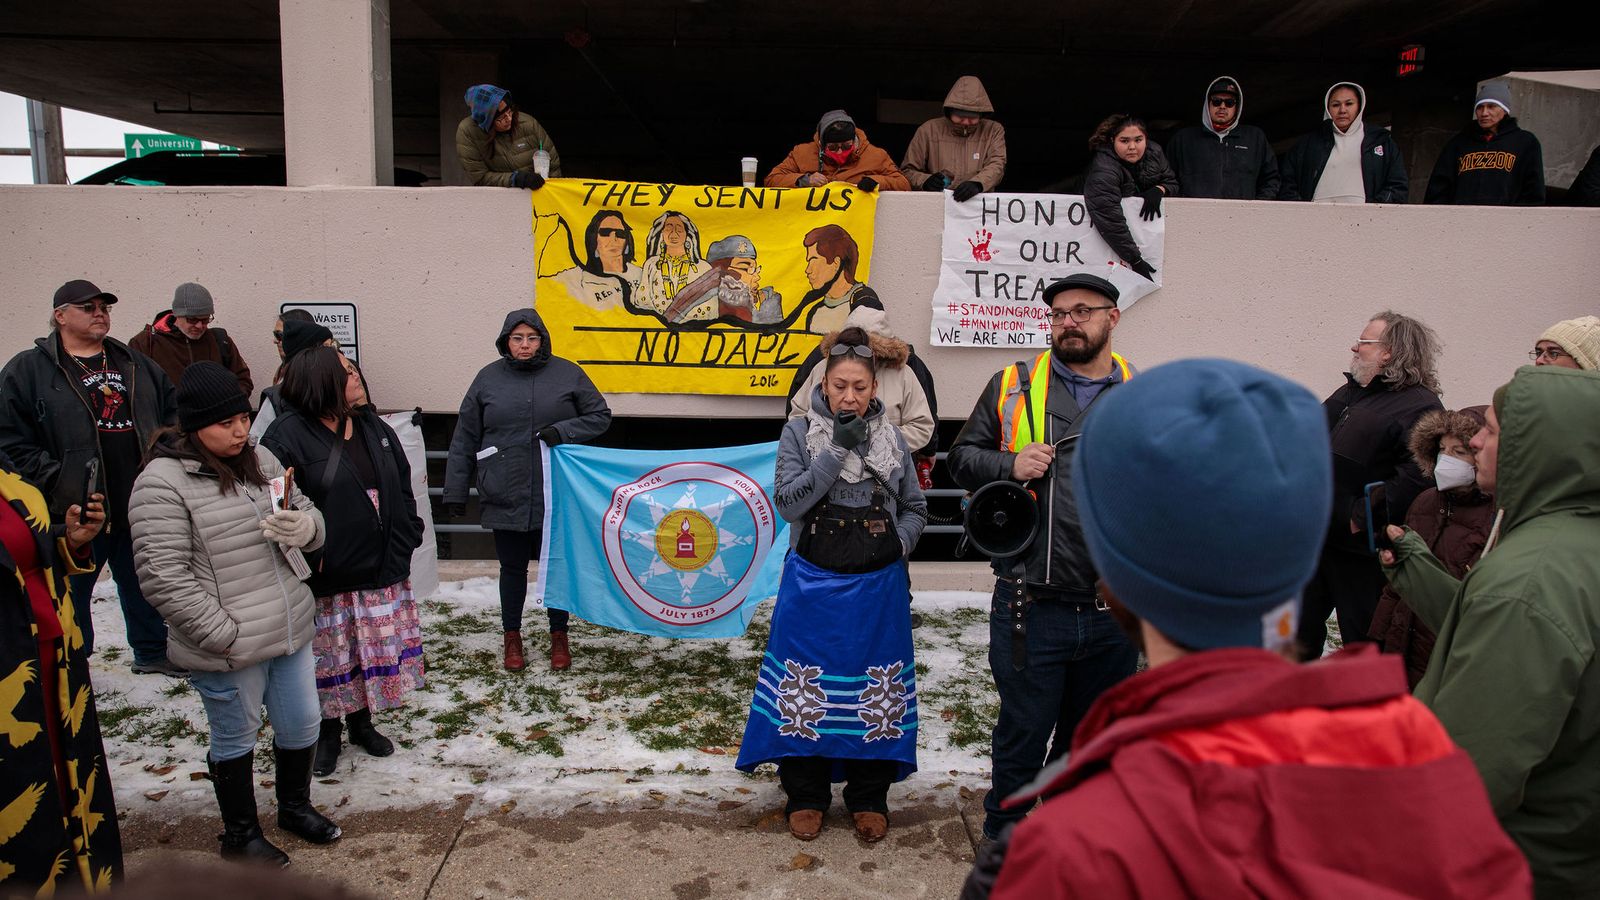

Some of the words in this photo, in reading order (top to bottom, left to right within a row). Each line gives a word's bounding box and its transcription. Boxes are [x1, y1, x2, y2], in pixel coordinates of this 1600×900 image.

[147, 138, 196, 150] University
[1459, 151, 1516, 174] MIZZOU
[582, 182, 677, 207] THEY
[694, 185, 793, 210] SENT
[805, 187, 854, 212] US
[981, 196, 1094, 229] HONO
[1019, 239, 1085, 265] OUR
[314, 314, 350, 323] WASTE
[937, 327, 961, 345] WE
[972, 331, 998, 345] ARE
[1007, 332, 1036, 345] NOT
[635, 331, 681, 364] NO
[700, 332, 801, 366] DAPL
[750, 374, 779, 388] 2016
[610, 487, 635, 525] STANDING
[637, 476, 662, 489] ROCK
[733, 479, 756, 498] SIOUX
[755, 499, 770, 527] TRIBE
[660, 607, 687, 619] JULY
[691, 607, 716, 619] 1873
